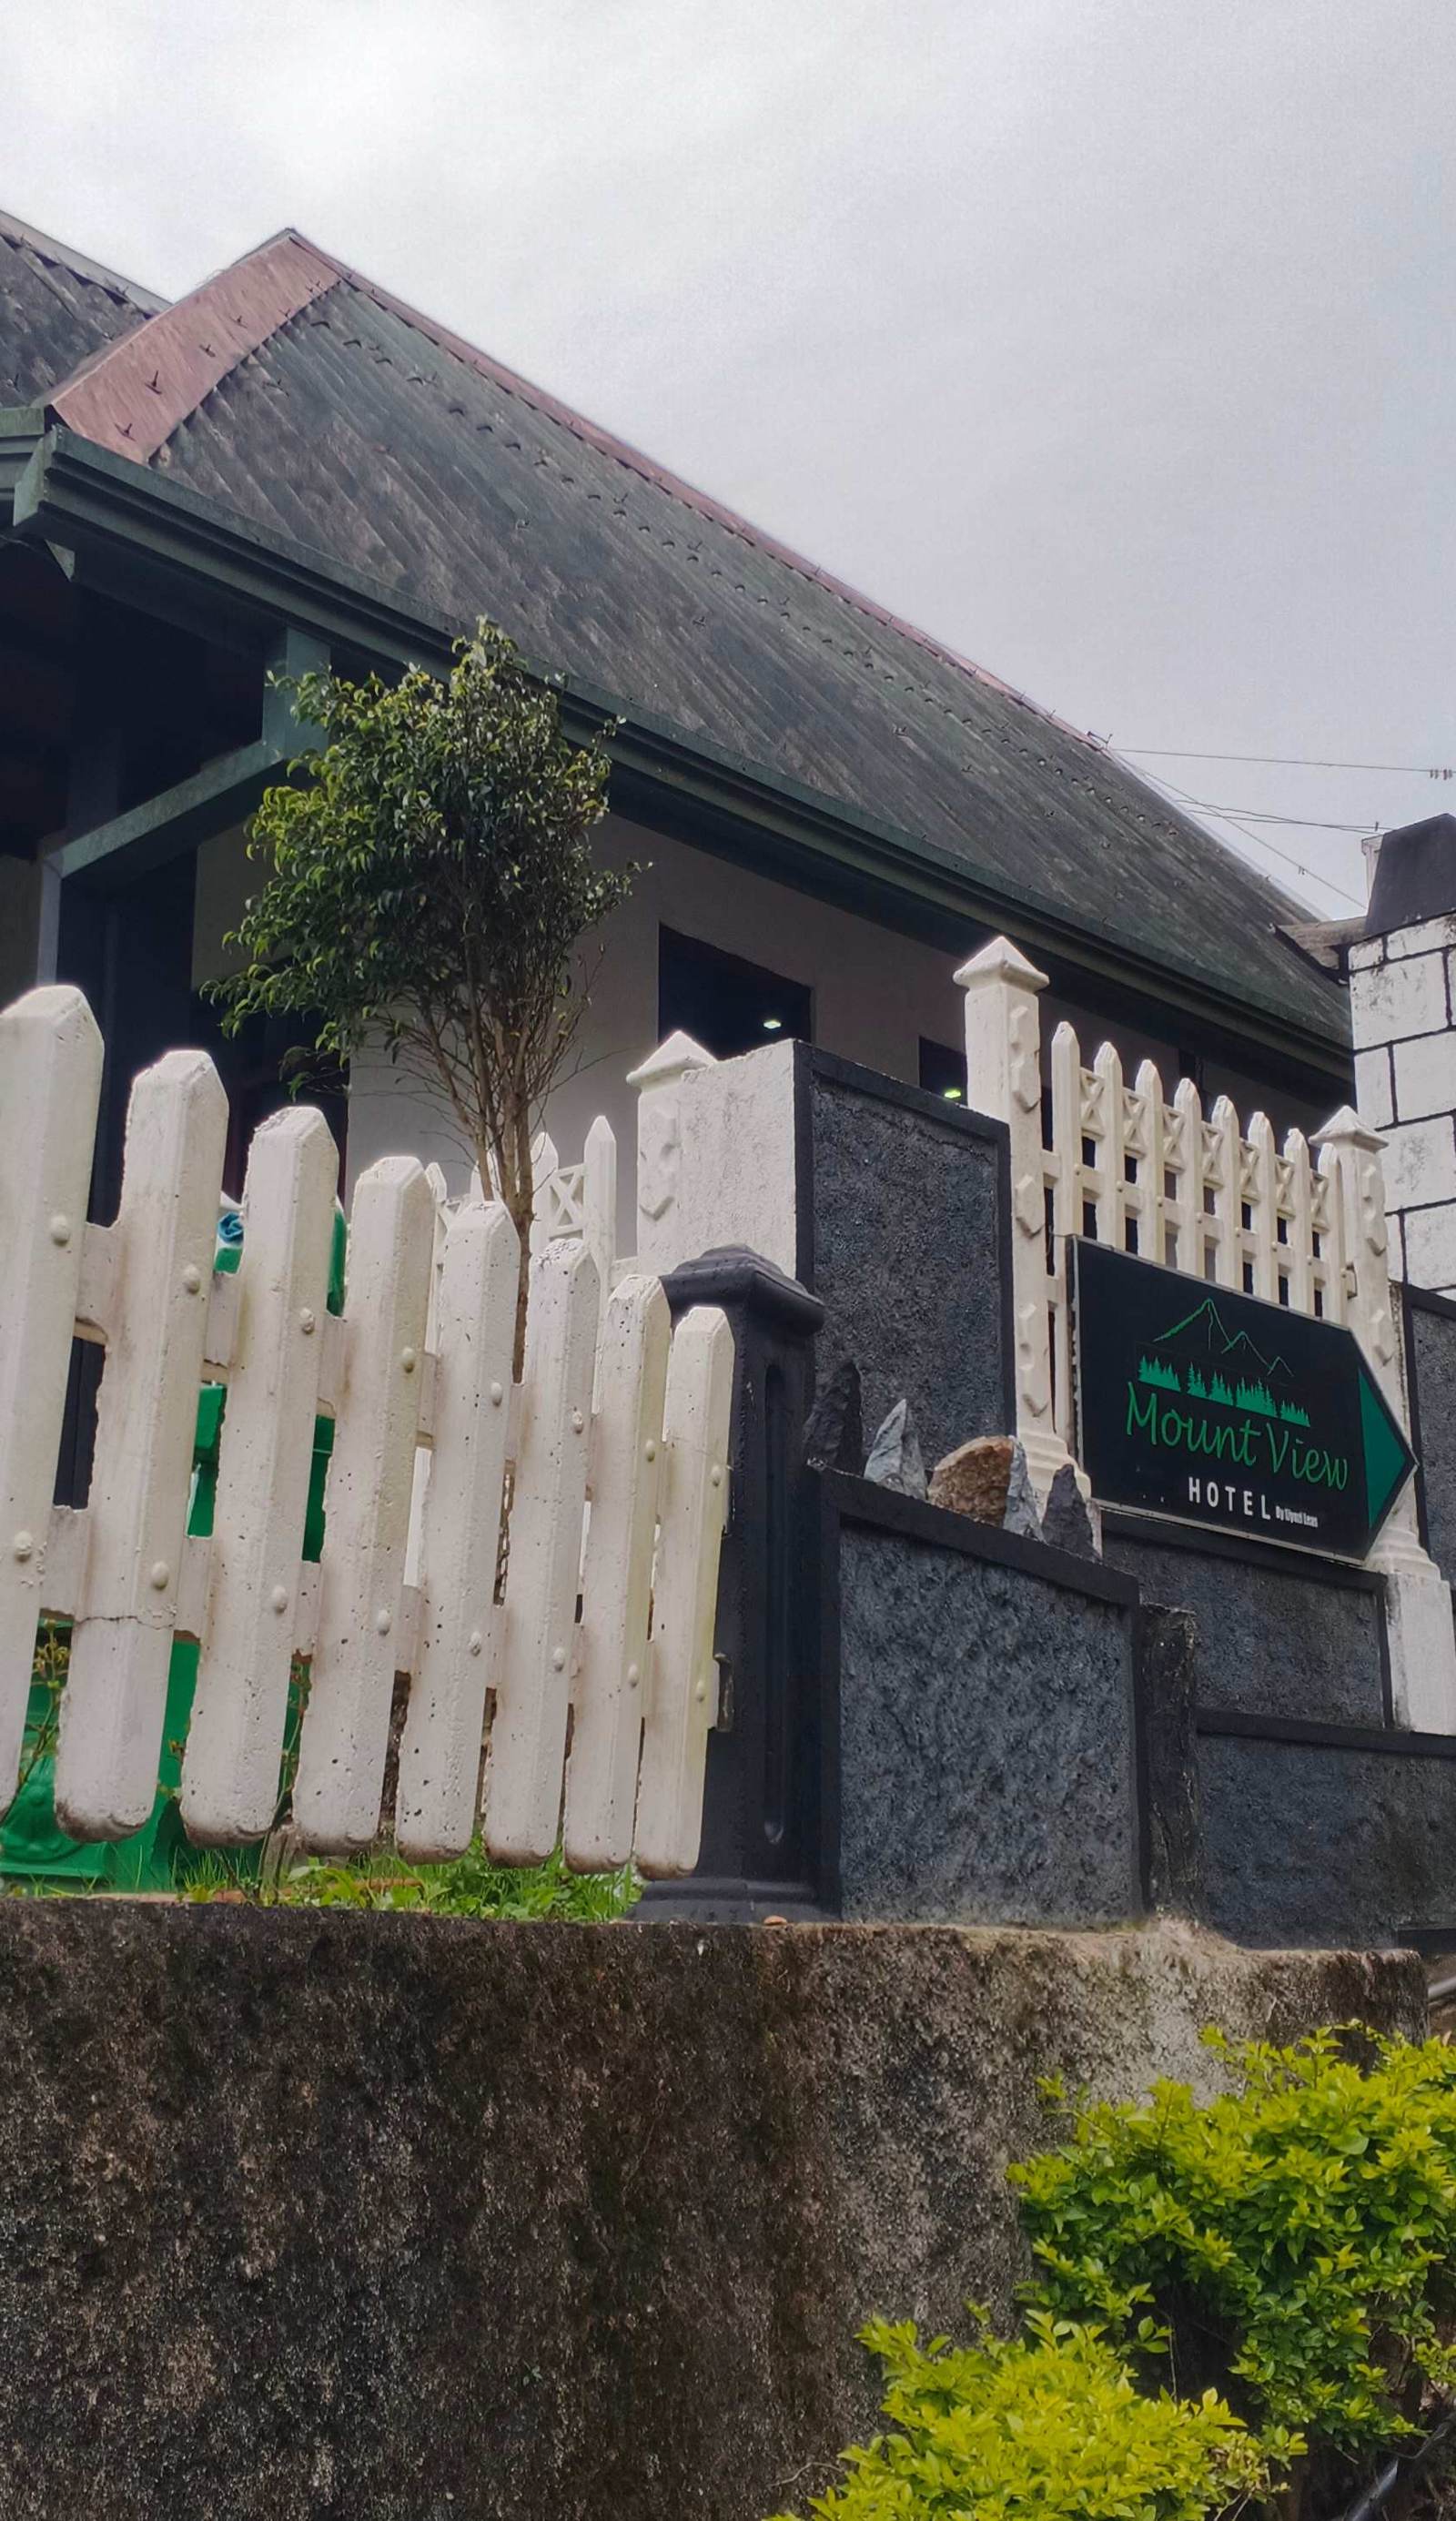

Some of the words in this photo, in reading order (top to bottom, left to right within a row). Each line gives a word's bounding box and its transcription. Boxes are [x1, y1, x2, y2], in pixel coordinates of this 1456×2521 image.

[1126, 1382, 1262, 1466] Mount
[1266, 1422, 1348, 1491] View
[1188, 1476, 1271, 1521] HOTEL
